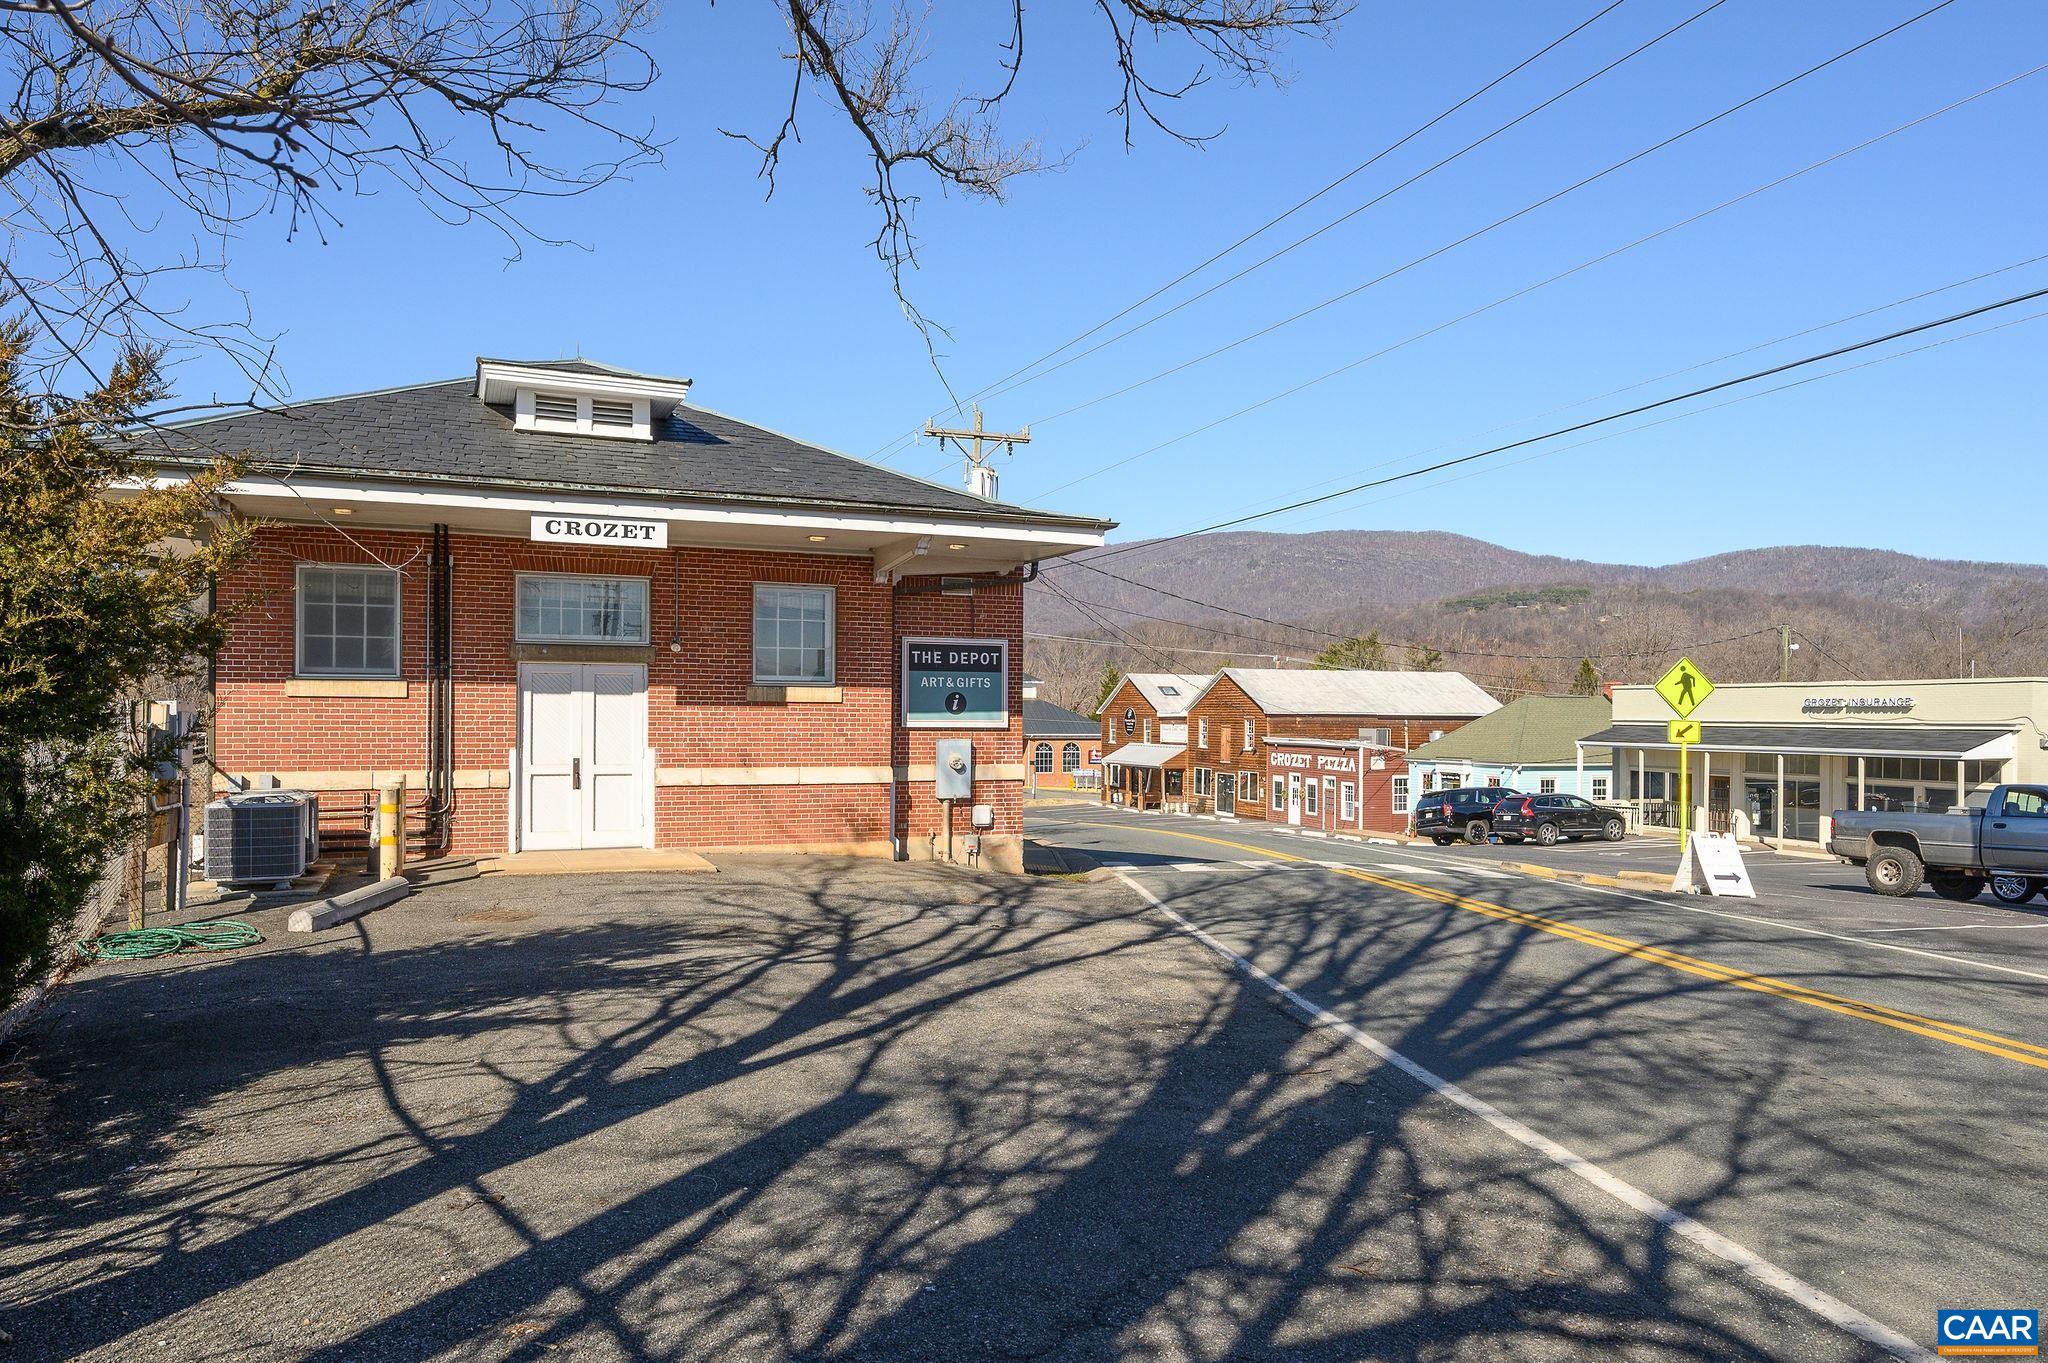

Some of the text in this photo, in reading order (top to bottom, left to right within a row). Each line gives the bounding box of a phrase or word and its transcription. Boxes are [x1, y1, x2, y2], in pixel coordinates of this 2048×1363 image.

[545, 519, 656, 540] CROZET
[911, 650, 1000, 665] THE DEPOT
[1803, 697, 1912, 707] CROZET INSURANCE
[1270, 752, 1357, 772] CROZET PIZZA
